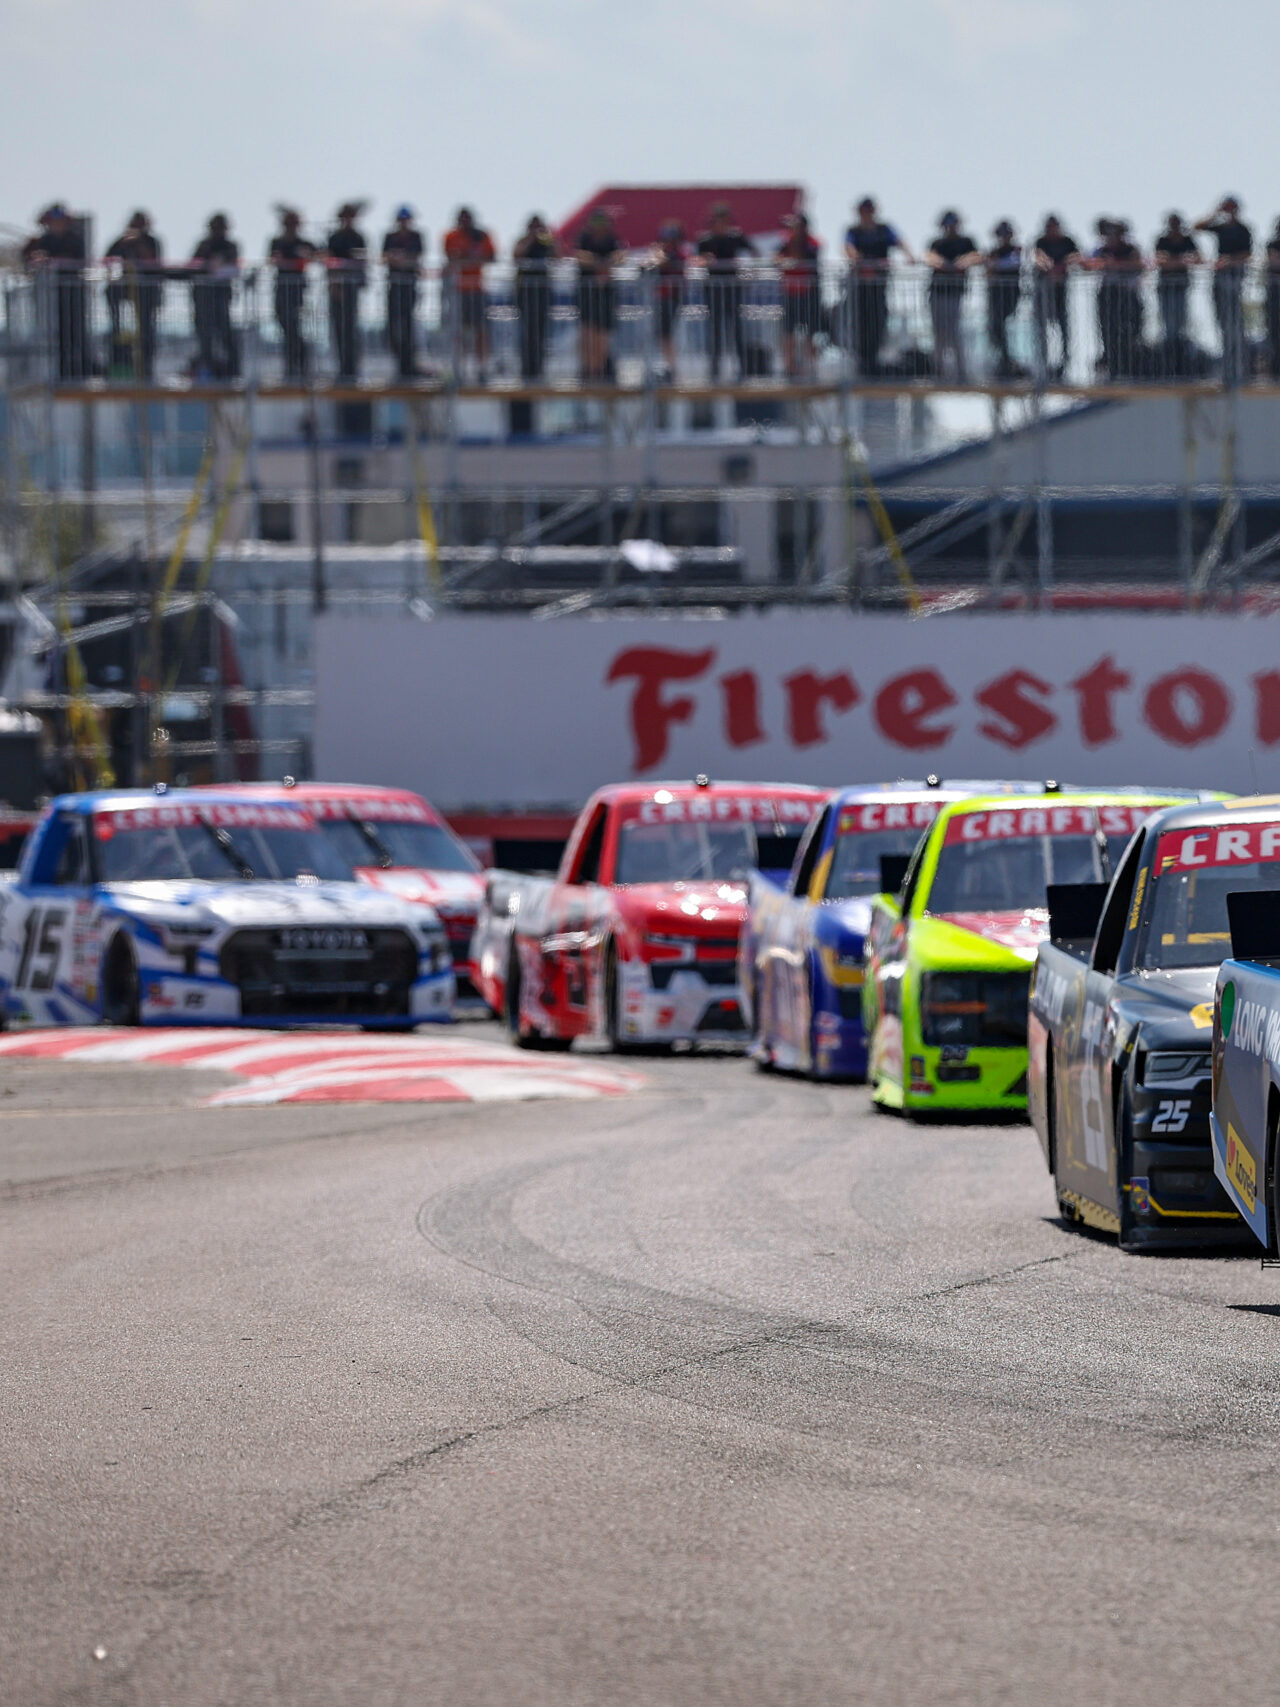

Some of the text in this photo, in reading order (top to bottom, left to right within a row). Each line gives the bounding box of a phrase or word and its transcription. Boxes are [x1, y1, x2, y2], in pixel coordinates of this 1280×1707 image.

[15, 906, 69, 991] 15
[1235, 998, 1267, 1057] LONG
[1151, 1100, 1191, 1132] 25
